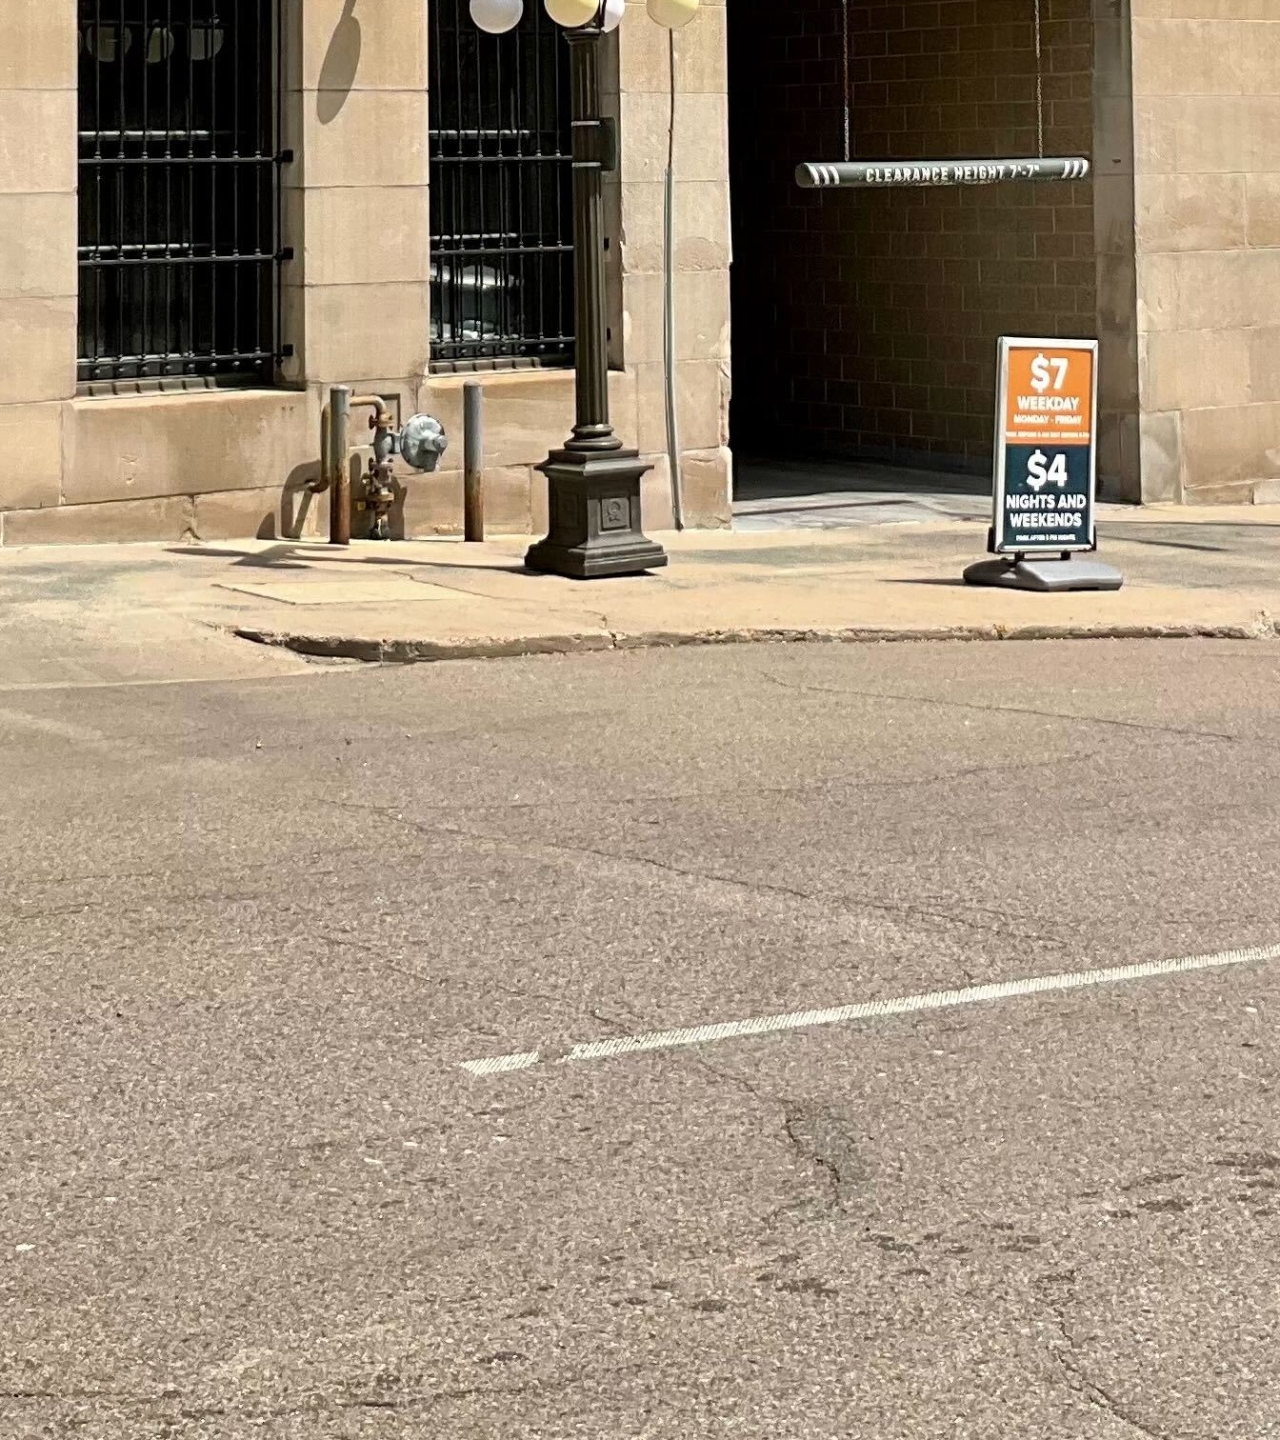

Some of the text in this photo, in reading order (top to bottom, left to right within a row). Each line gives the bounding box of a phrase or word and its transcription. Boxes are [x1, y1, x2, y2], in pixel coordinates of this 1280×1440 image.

[866, 167, 949, 182] CLEARANCE
[954, 165, 1005, 180] HEIGHT
[1030, 352, 1069, 394] $7
[1017, 395, 1080, 411] WEEKDAY
[1013, 413, 1050, 424] MONDAY
[1055, 414, 1082, 425] FRIDAY
[1026, 449, 1068, 492] $4
[1006, 494, 1087, 509] NIGHTS AND
[1010, 512, 1082, 527] WEEKENDS
